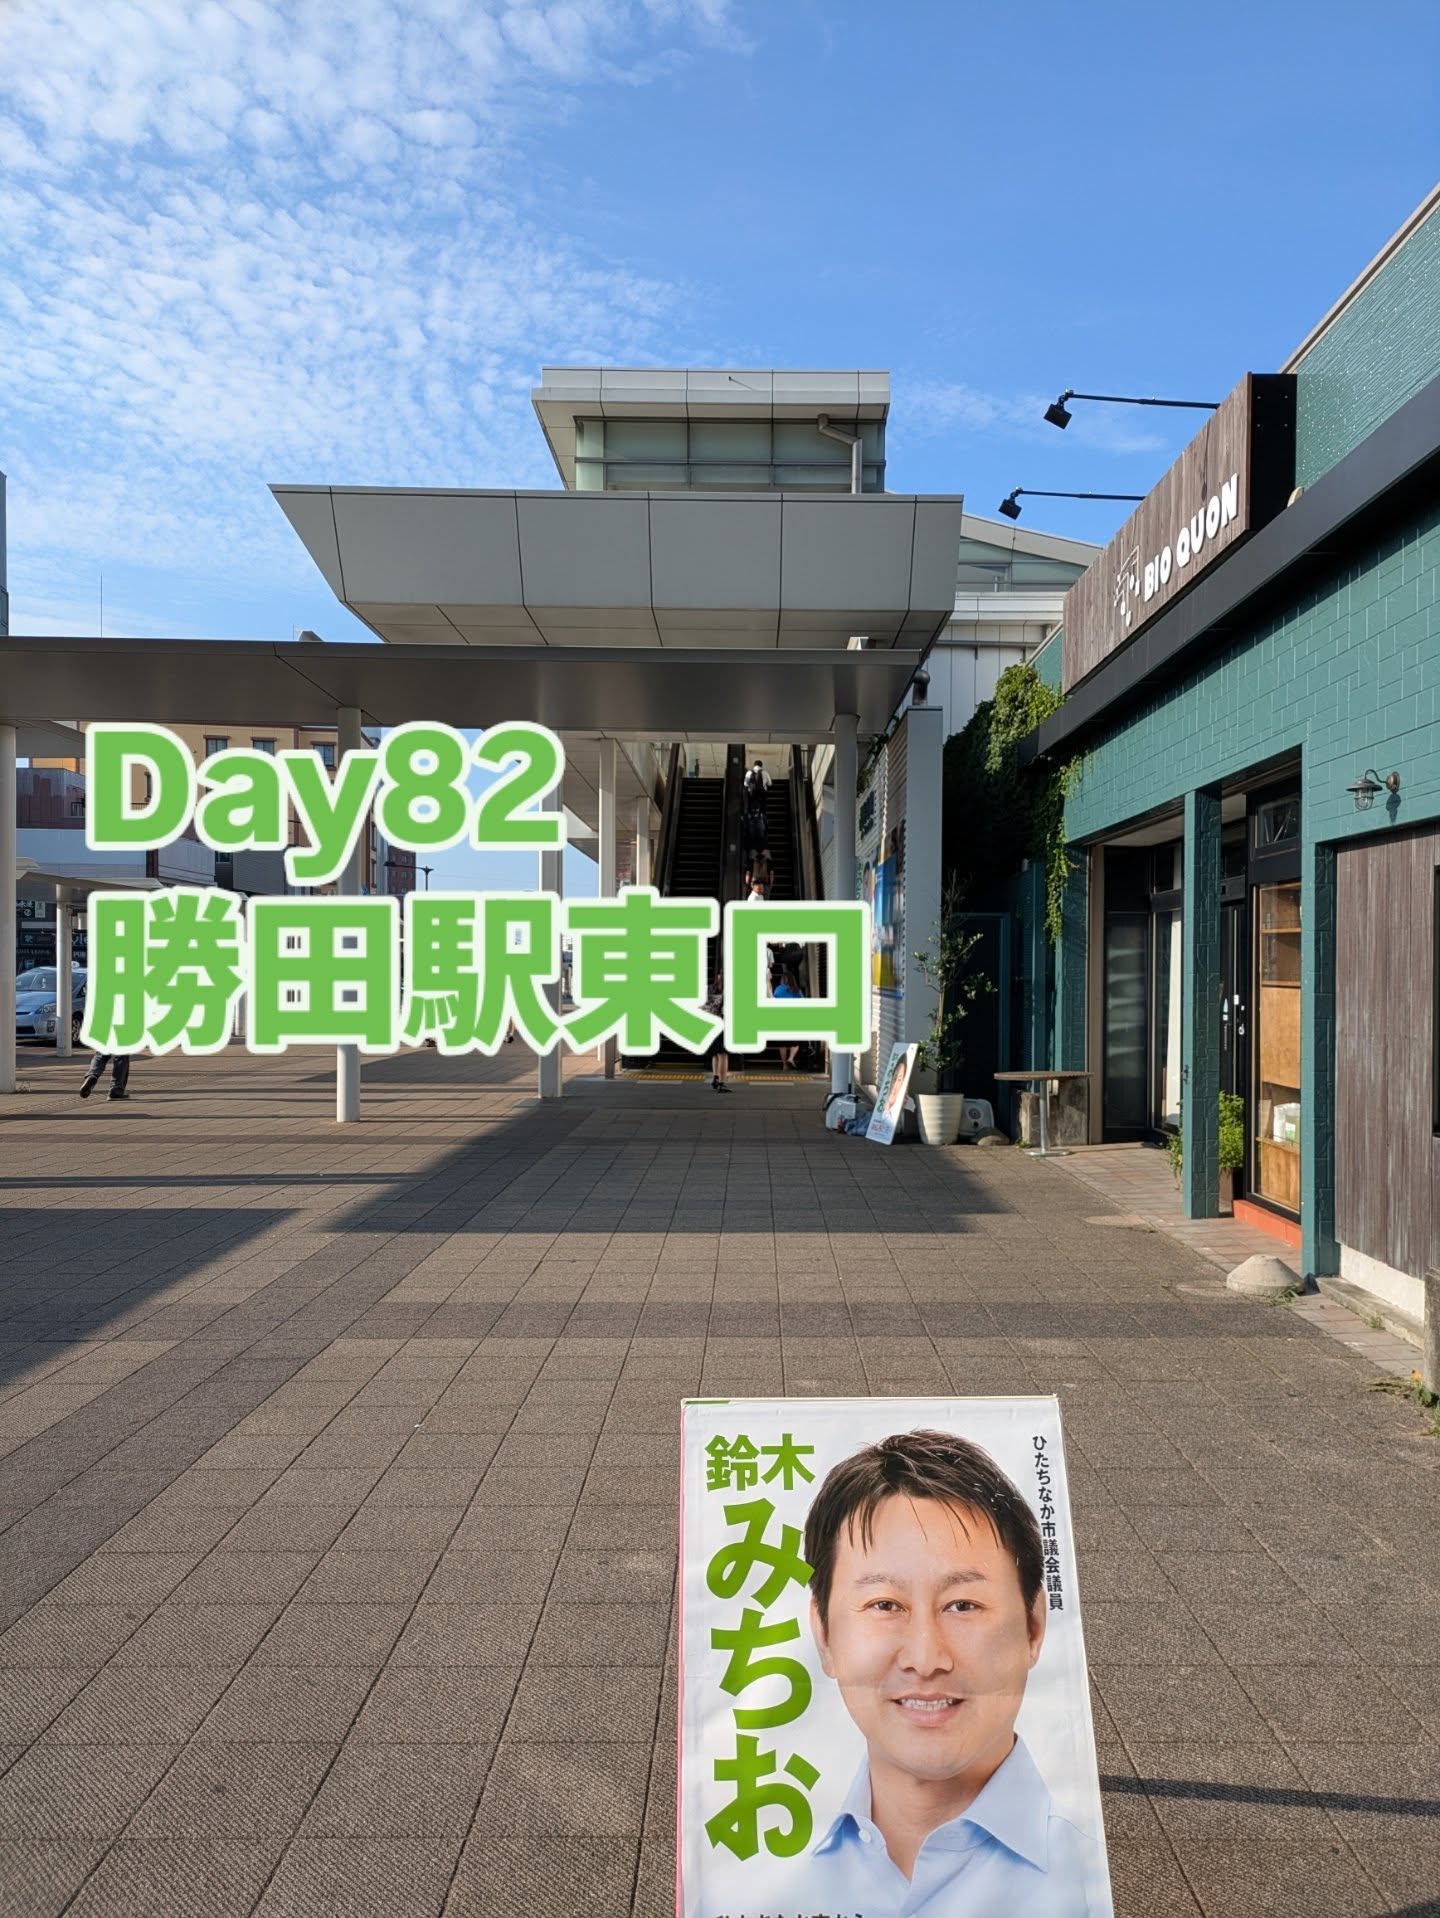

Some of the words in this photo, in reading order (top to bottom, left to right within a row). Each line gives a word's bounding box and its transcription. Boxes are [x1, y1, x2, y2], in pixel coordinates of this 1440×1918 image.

[1144, 546, 1172, 602] BIO
[1176, 472, 1239, 568] QUON
[705, 1433, 815, 1492] 鈴木
[1032, 1434, 1064, 1611] ひたちなか市議会議員
[704, 1497, 821, 1862] みちお
